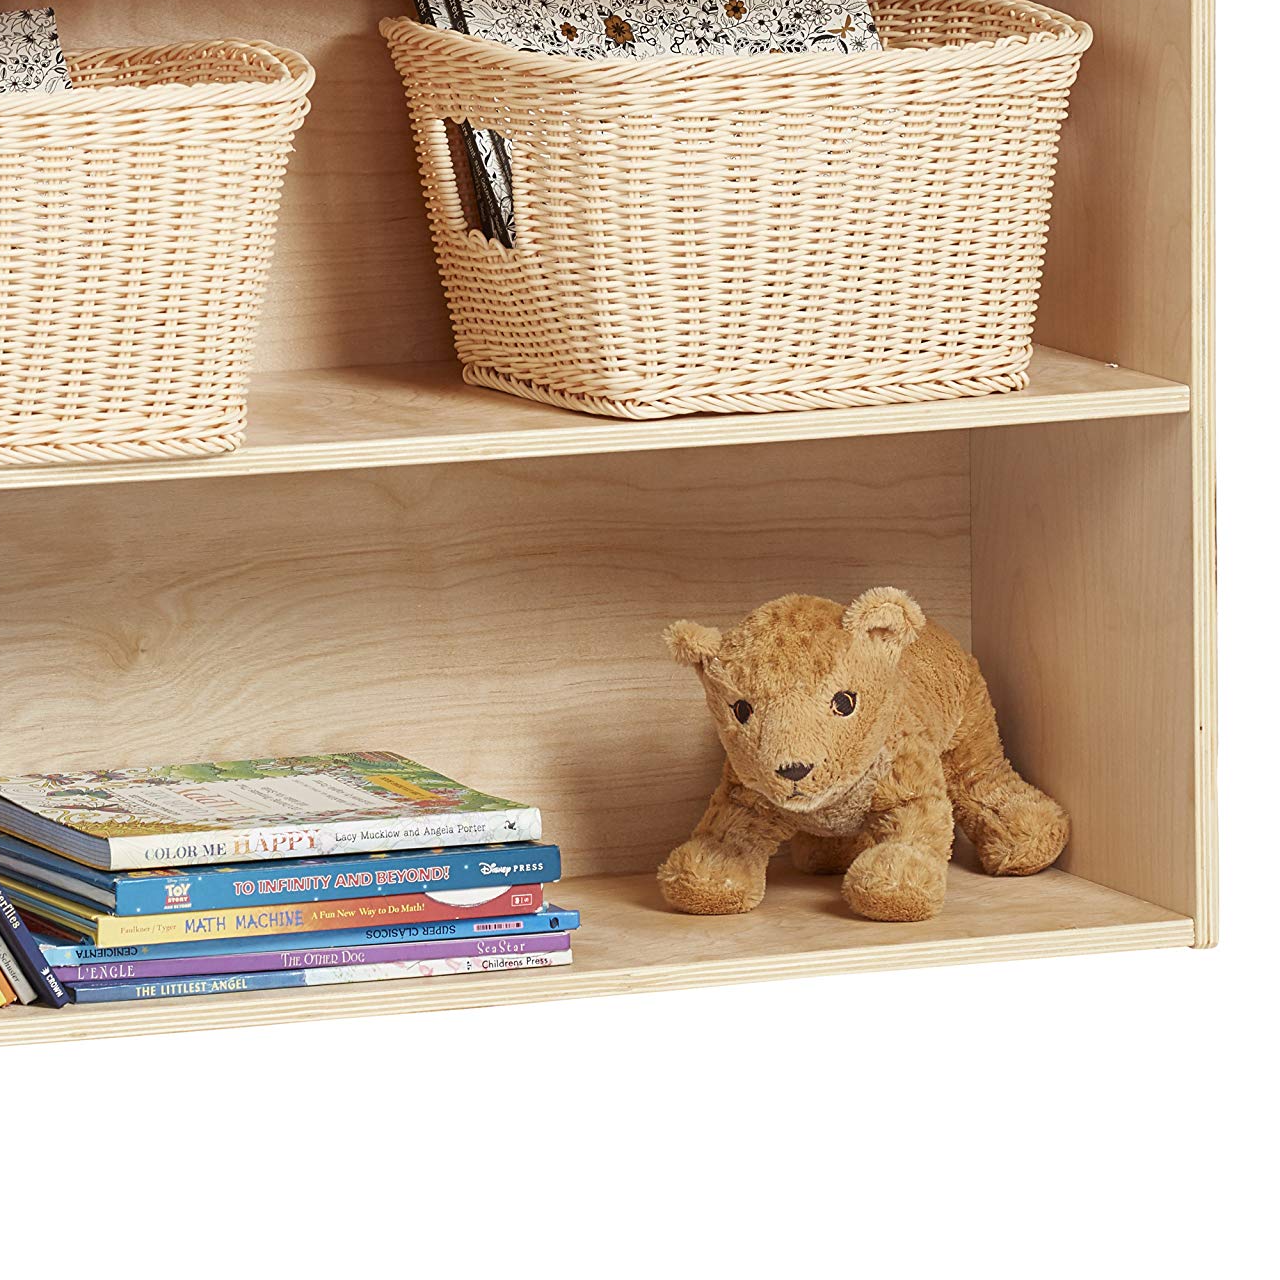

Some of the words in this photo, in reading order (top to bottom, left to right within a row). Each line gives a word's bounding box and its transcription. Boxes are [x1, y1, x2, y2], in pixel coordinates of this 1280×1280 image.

[335, 831, 357, 843] Lacy
[360, 827, 401, 841] Mucklow
[403, 826, 421, 837] and
[423, 825, 455, 837] Angela
[457, 823, 486, 835] Porter
[145, 845, 198, 861] COLOR
[202, 842, 227, 857] ME
[233, 829, 321, 856] HAPPY
[478, 862, 512, 877] Disney
[513, 862, 544, 873] PRESS
[233, 881, 254, 896] TO
[257, 874, 332, 895] INFINITY
[334, 871, 373, 889] AND
[375, 865, 451, 885] BEYOND!
[164, 883, 191, 897] TOY
[167, 896, 189, 904] STORY
[311, 911, 319, 920] A
[319, 910, 336, 920] Fun
[337, 908, 356, 918] New
[359, 907, 377, 919] Way
[378, 906, 387, 915] to
[388, 905, 400, 914] Do
[401, 903, 425, 914] Math!
[120, 925, 151, 935] Faulkner
[157, 923, 177, 934] Tyger
[185, 916, 227, 934] MATH
[235, 910, 304, 930] MACHINE
[422, 924, 457, 935] SUPER
[75, 946, 138, 959] CENICIENTA
[281, 952, 302, 967] THE
[303, 952, 338, 966] OTHER
[341, 950, 366, 964] DOG
[0, 953, 21, 984] Schuster
[482, 959, 524, 970] Childrens
[525, 957, 549, 967] Press
[77, 965, 136, 980] L'ENGLE
[46, 972, 64, 998] CROWN
[135, 986, 158, 997] THE
[160, 981, 208, 995] LITTLEST
[211, 978, 248, 992] ANGEL
